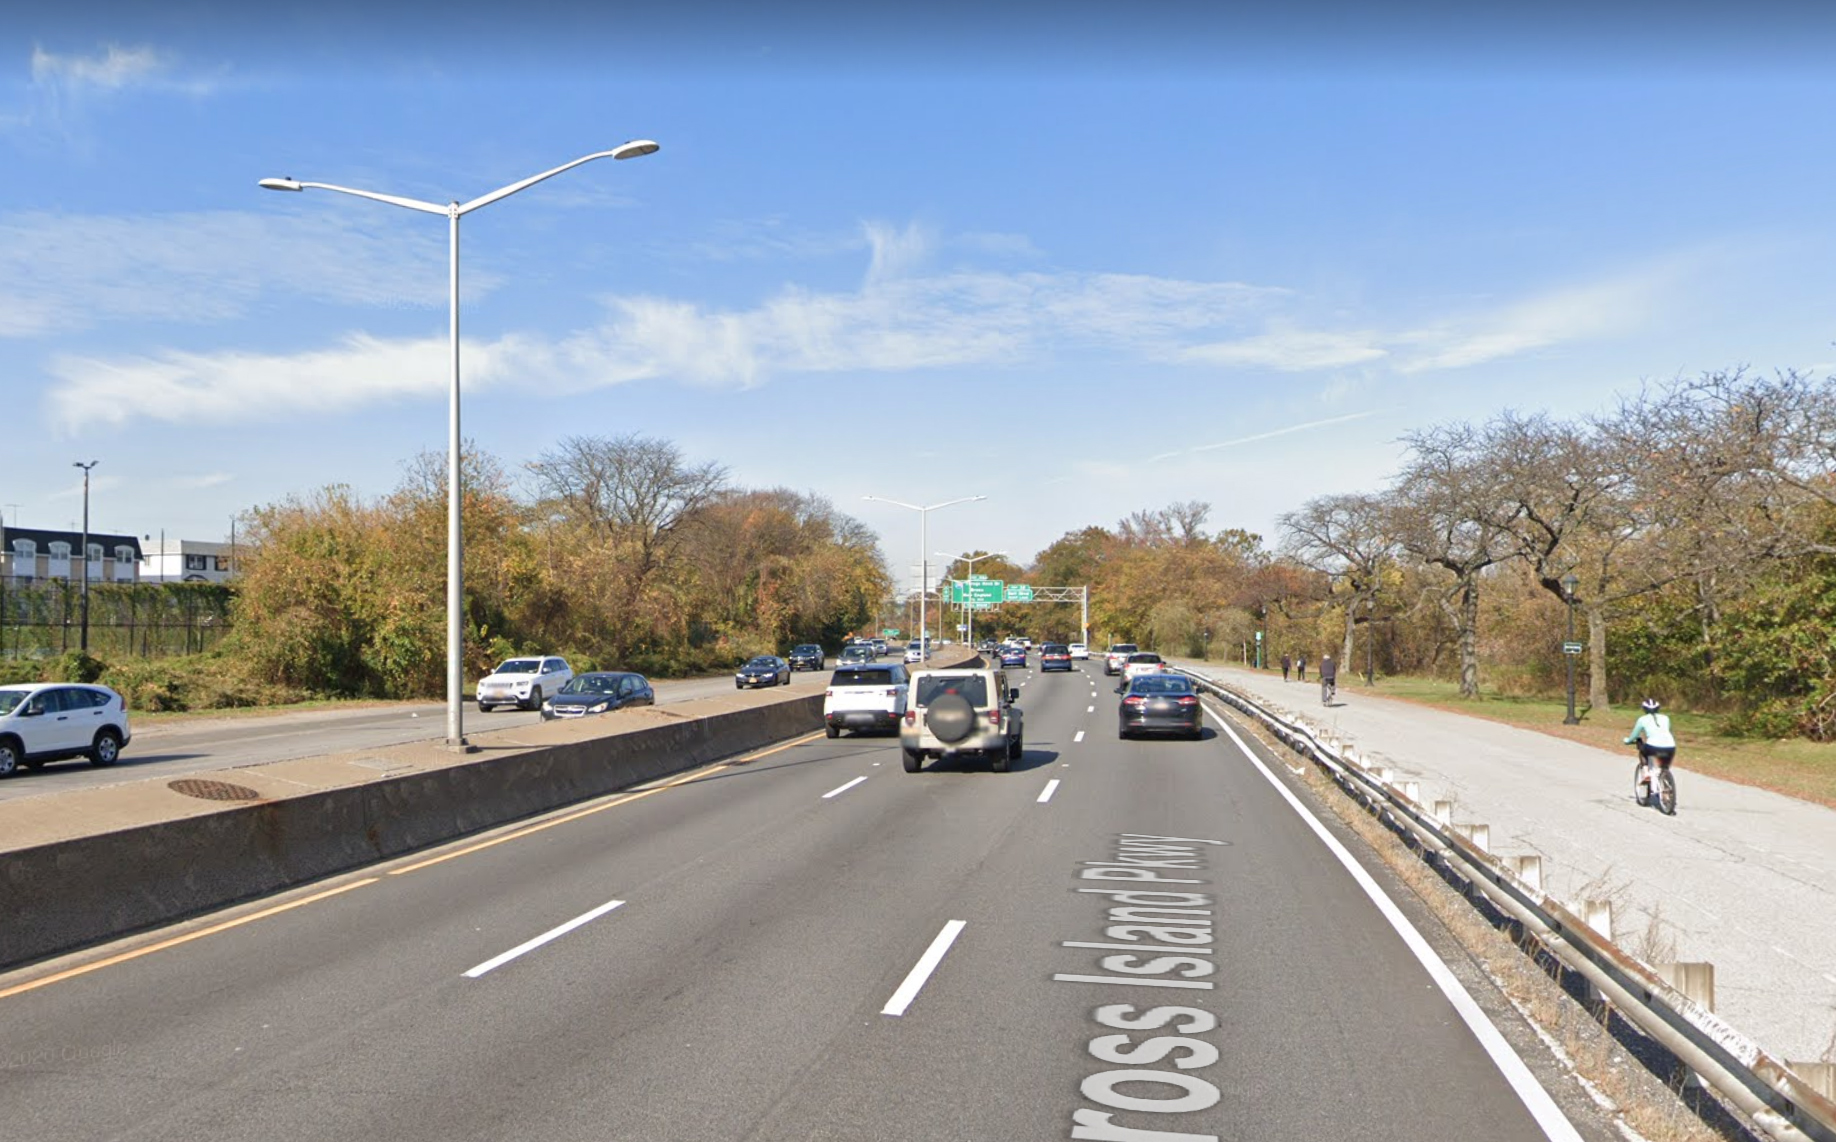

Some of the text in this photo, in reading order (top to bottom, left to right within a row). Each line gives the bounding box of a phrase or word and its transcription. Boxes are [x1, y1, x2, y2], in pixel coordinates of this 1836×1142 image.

[1053, 833, 1232, 1142] ross Island Pkwy
